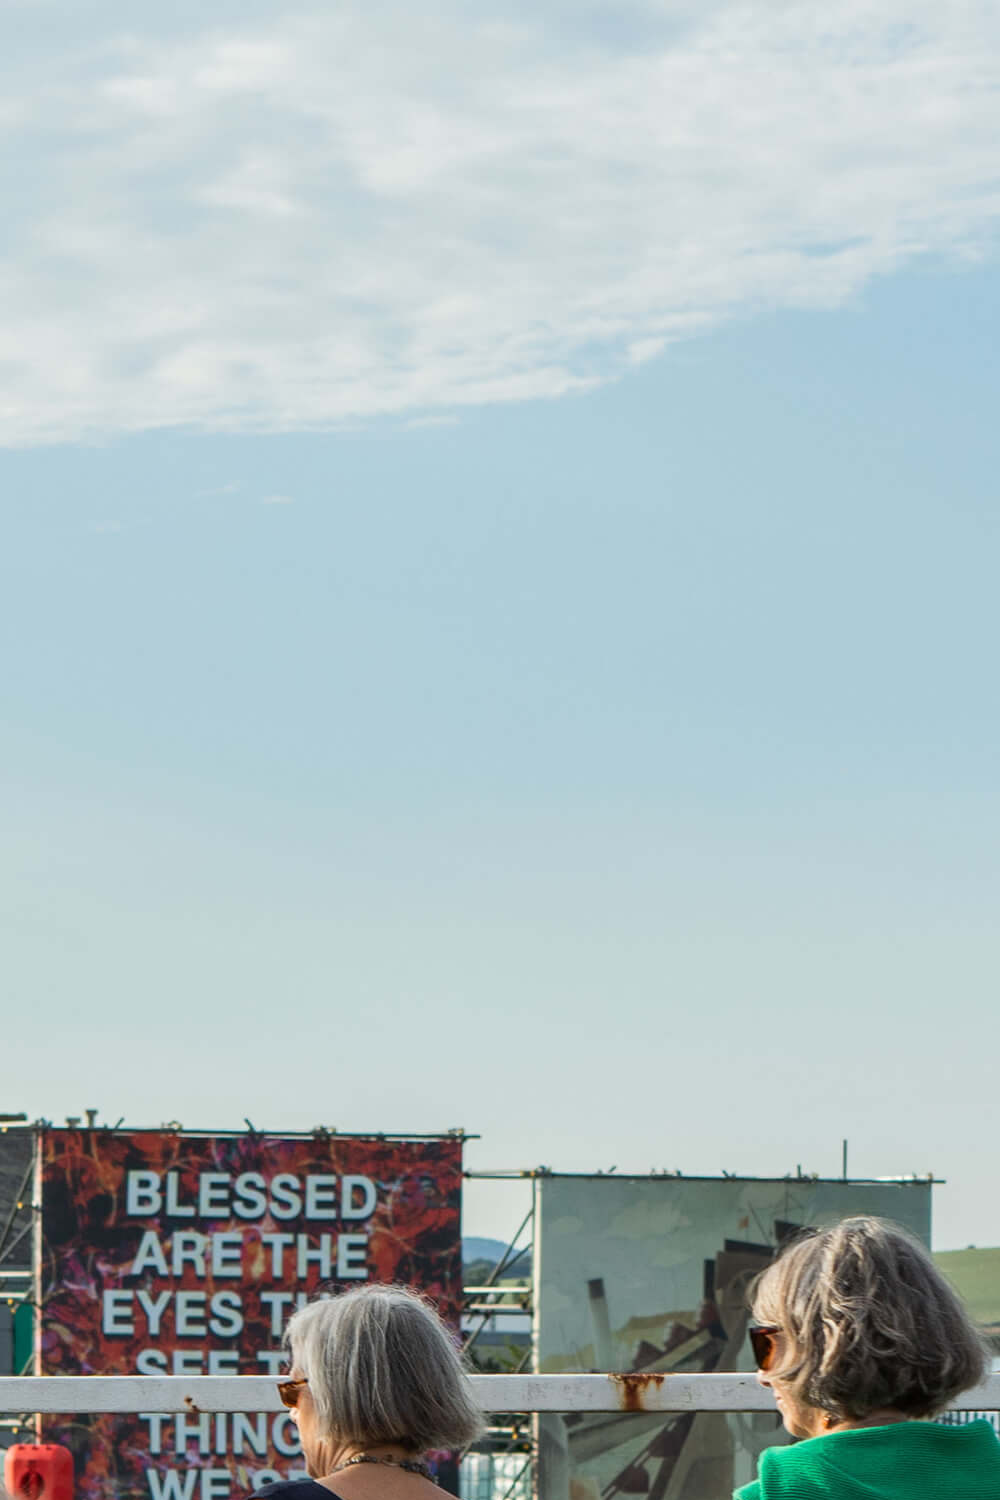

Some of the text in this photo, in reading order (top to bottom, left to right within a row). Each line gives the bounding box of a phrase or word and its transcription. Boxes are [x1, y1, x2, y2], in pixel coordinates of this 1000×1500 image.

[126, 1170, 378, 1220] BLESSED
[131, 1231, 369, 1279] ARE THE
[102, 1289, 244, 1338] EYES
[138, 1412, 302, 1456] THING
